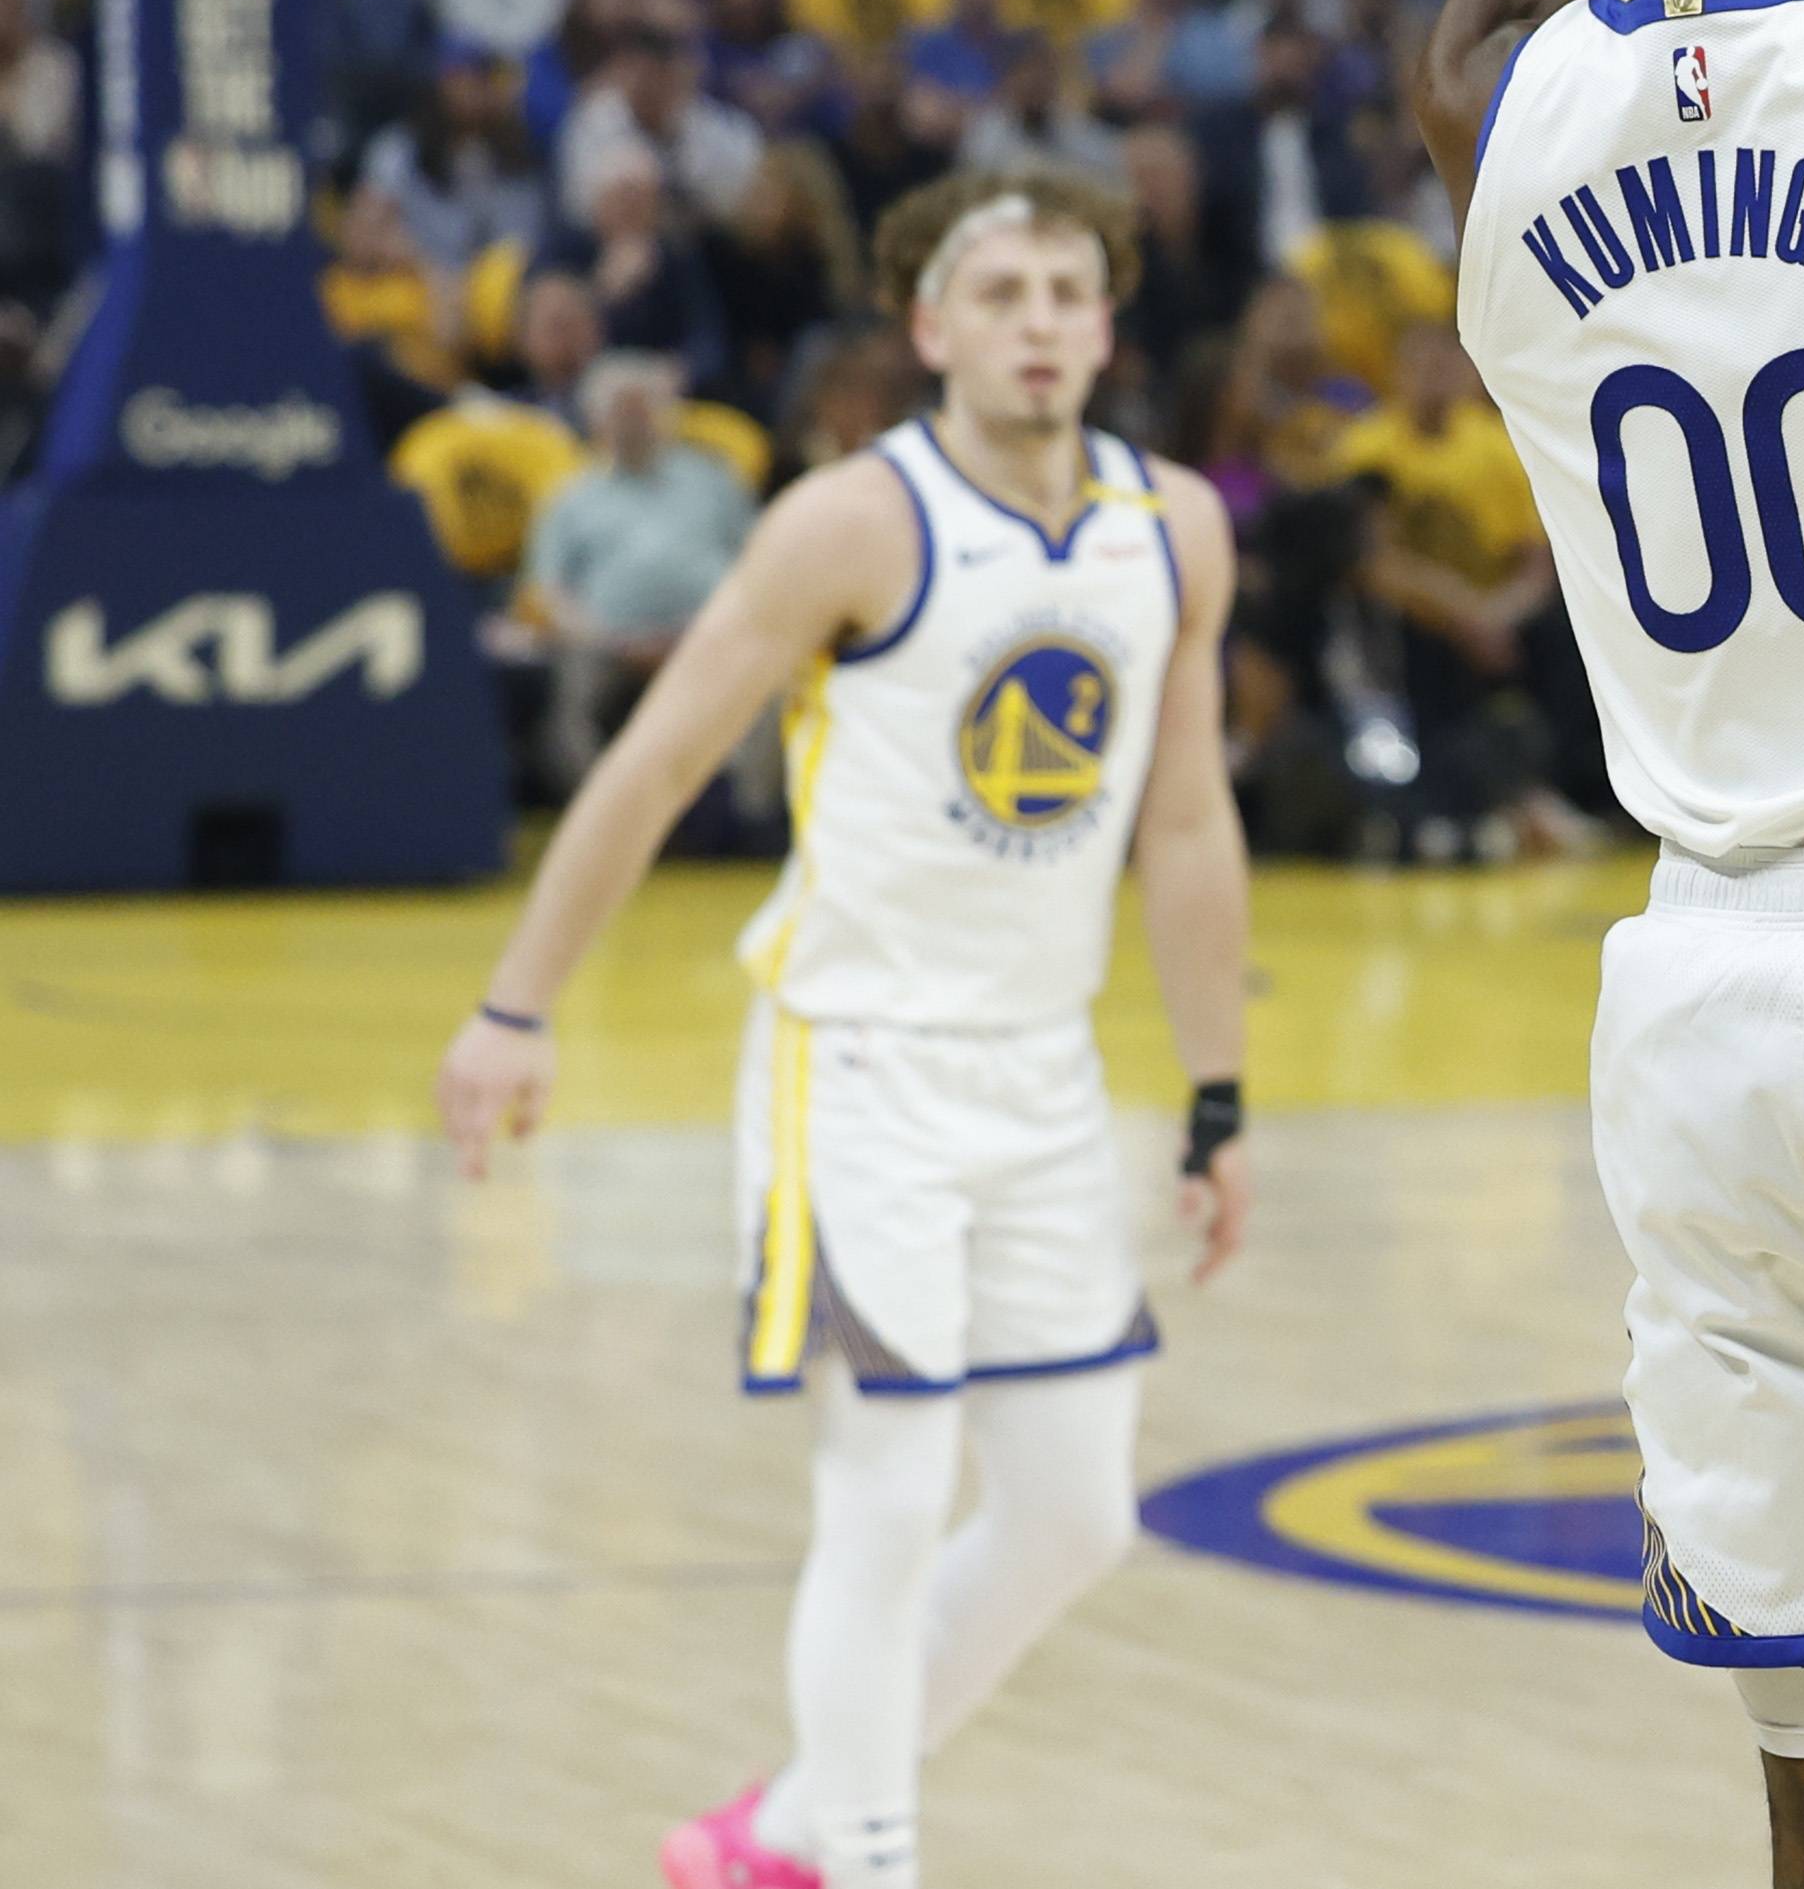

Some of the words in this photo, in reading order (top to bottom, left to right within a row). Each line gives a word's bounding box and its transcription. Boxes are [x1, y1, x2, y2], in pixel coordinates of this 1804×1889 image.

[1681, 105, 1700, 120] NBA
[123, 385, 342, 482] Google
[1070, 673, 1101, 737] 2
